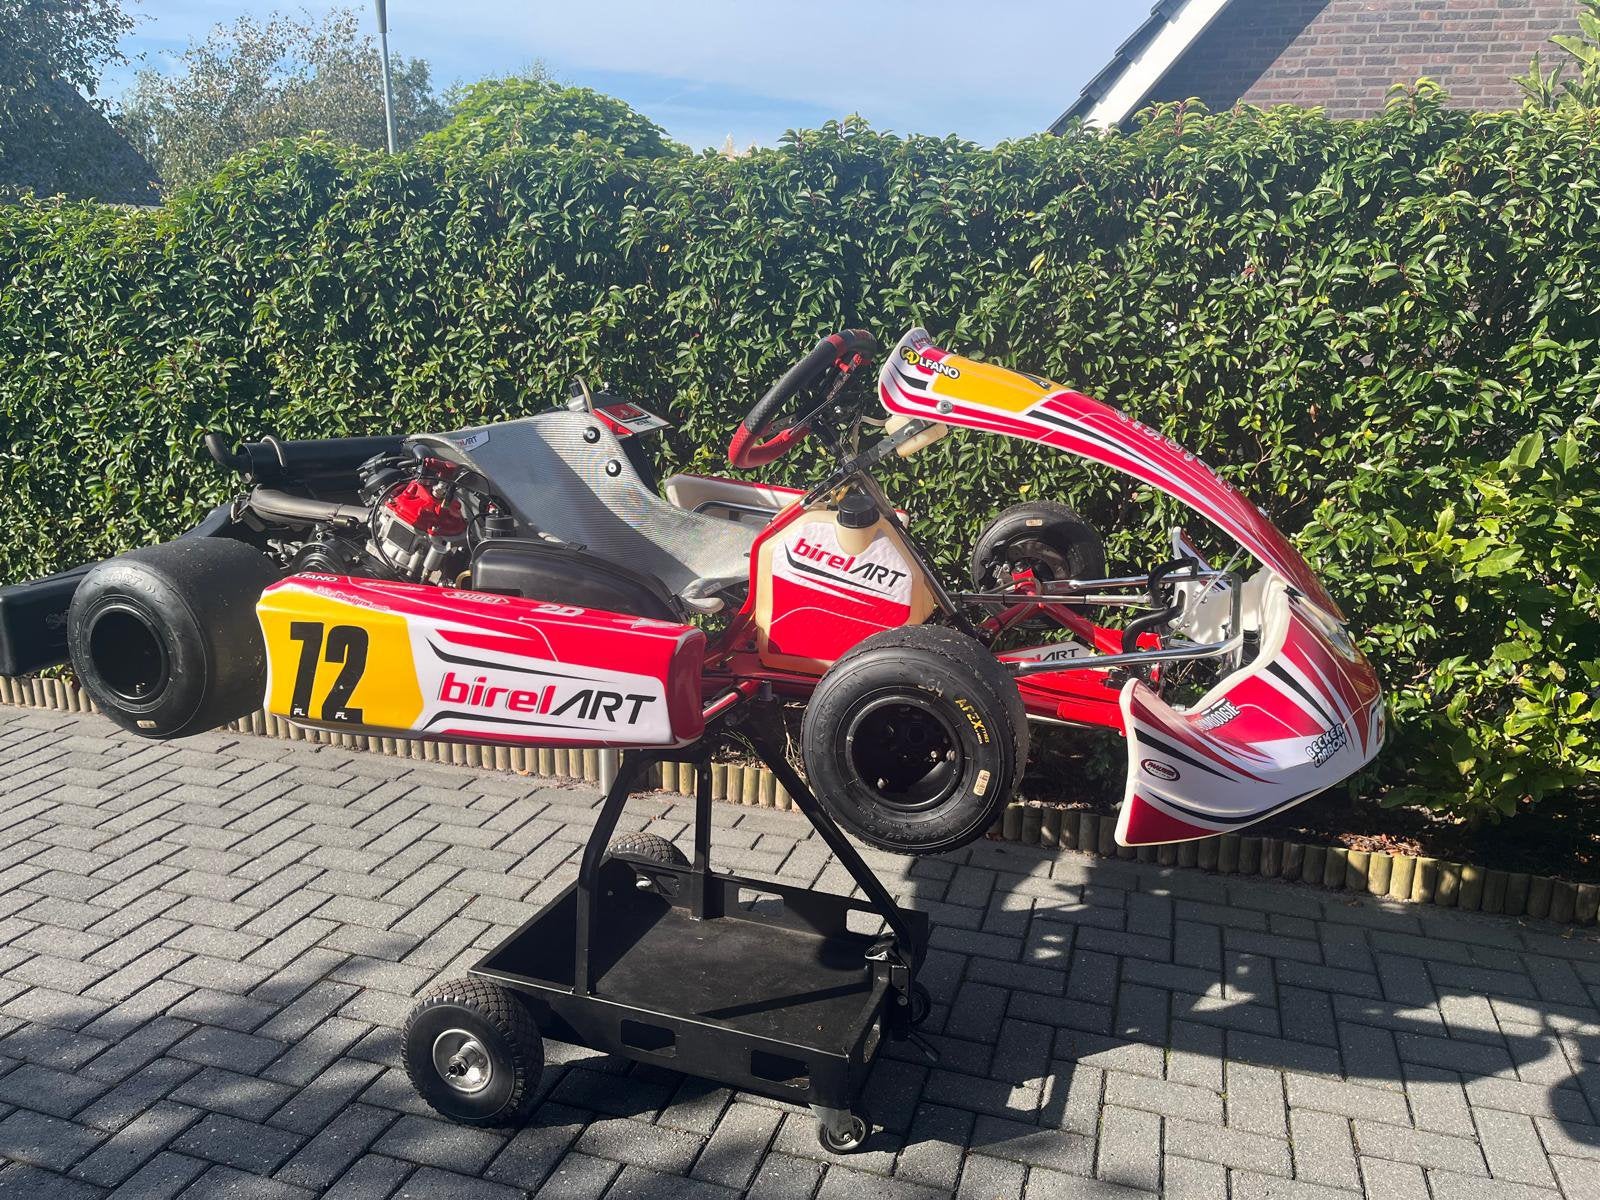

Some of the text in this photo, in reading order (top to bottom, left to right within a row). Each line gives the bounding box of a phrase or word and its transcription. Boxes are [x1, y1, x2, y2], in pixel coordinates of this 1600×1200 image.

[900, 346, 960, 379] ALFANO
[793, 537, 907, 587] birelART
[438, 672, 657, 725] birelART
[335, 712, 348, 720] FL
[1306, 724, 1344, 758] BECKER
[1314, 734, 1347, 767] CARBON
